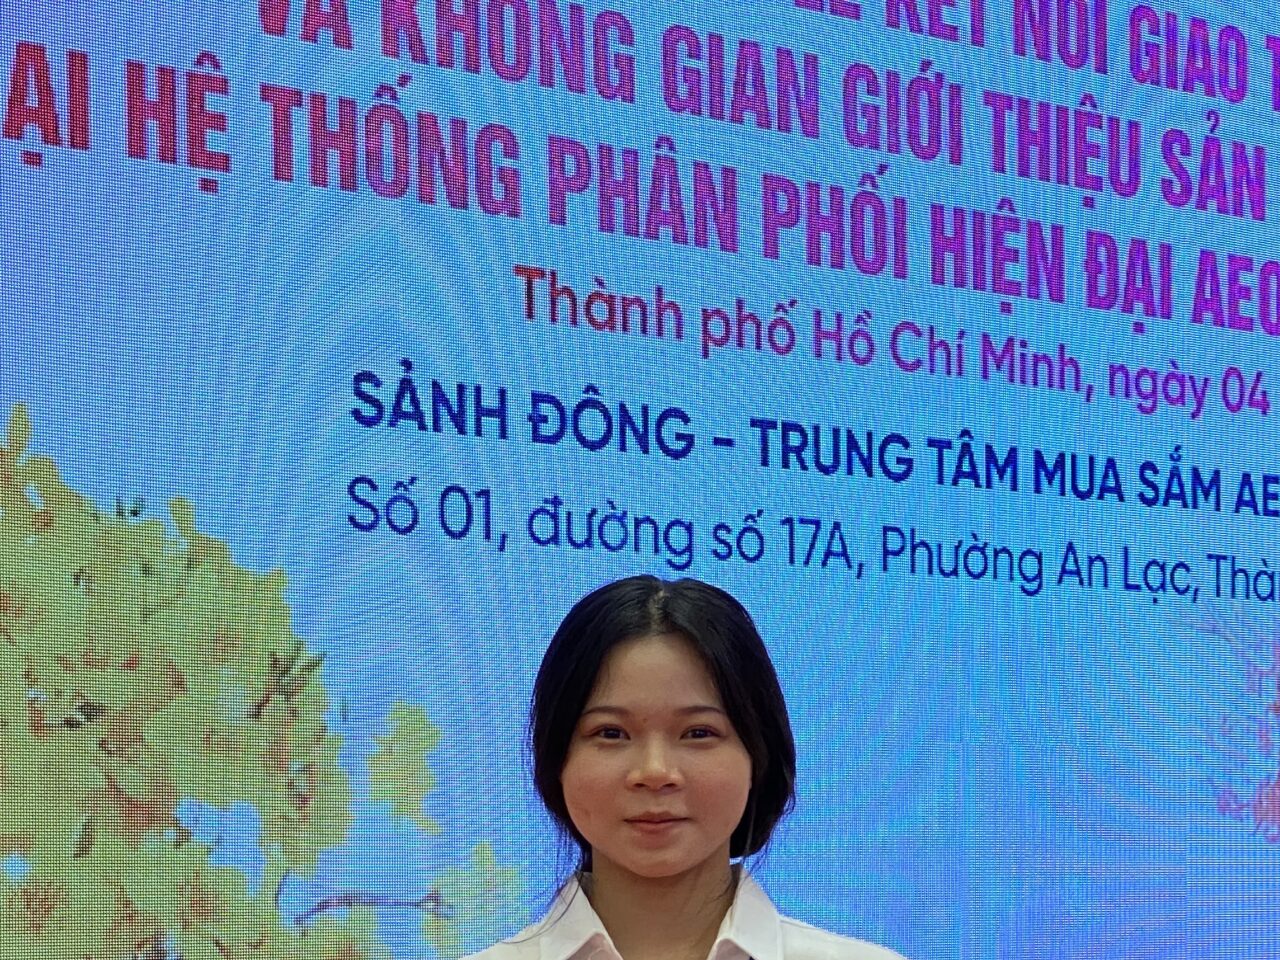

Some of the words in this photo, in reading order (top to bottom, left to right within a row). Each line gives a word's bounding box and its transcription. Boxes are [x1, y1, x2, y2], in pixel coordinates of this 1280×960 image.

[662, 24, 820, 140] GIAN
[842, 60, 963, 165] GIỚI
[984, 92, 1141, 208] THIỆU
[1161, 110, 1266, 222] SẢN
[1128, 4, 1248, 103] GIAO
[125, 51, 231, 193] HỆ
[259, 73, 521, 218] THỐNG
[547, 134, 738, 254] PHÂN
[761, 164, 908, 279] PHỐI
[930, 198, 1066, 315] HIỆN
[1084, 229, 1174, 334] ĐẠI
[514, 265, 683, 340] Thành
[702, 298, 797, 359] phố
[813, 309, 875, 366] Hồ
[890, 320, 966, 377] Chí
[981, 331, 1094, 402] Minh,
[1109, 360, 1209, 420] ngày
[1222, 366, 1270, 416] 04
[351, 357, 508, 440] SẢNH
[527, 384, 695, 460] ĐÔNG
[713, 436, 735, 448] -
[750, 418, 914, 483] TRUNG
[927, 428, 1018, 492] TÂM
[1034, 448, 1125, 502] MUA
[1137, 445, 1221, 513] SẮM
[346, 475, 419, 535] Số
[438, 485, 508, 552] 01,
[528, 495, 694, 572] đường
[712, 508, 765, 563] số
[780, 516, 864, 580] 17A,
[881, 526, 1043, 597] Phường
[1057, 541, 1109, 588] An
[1123, 546, 1199, 602] Lạc,
